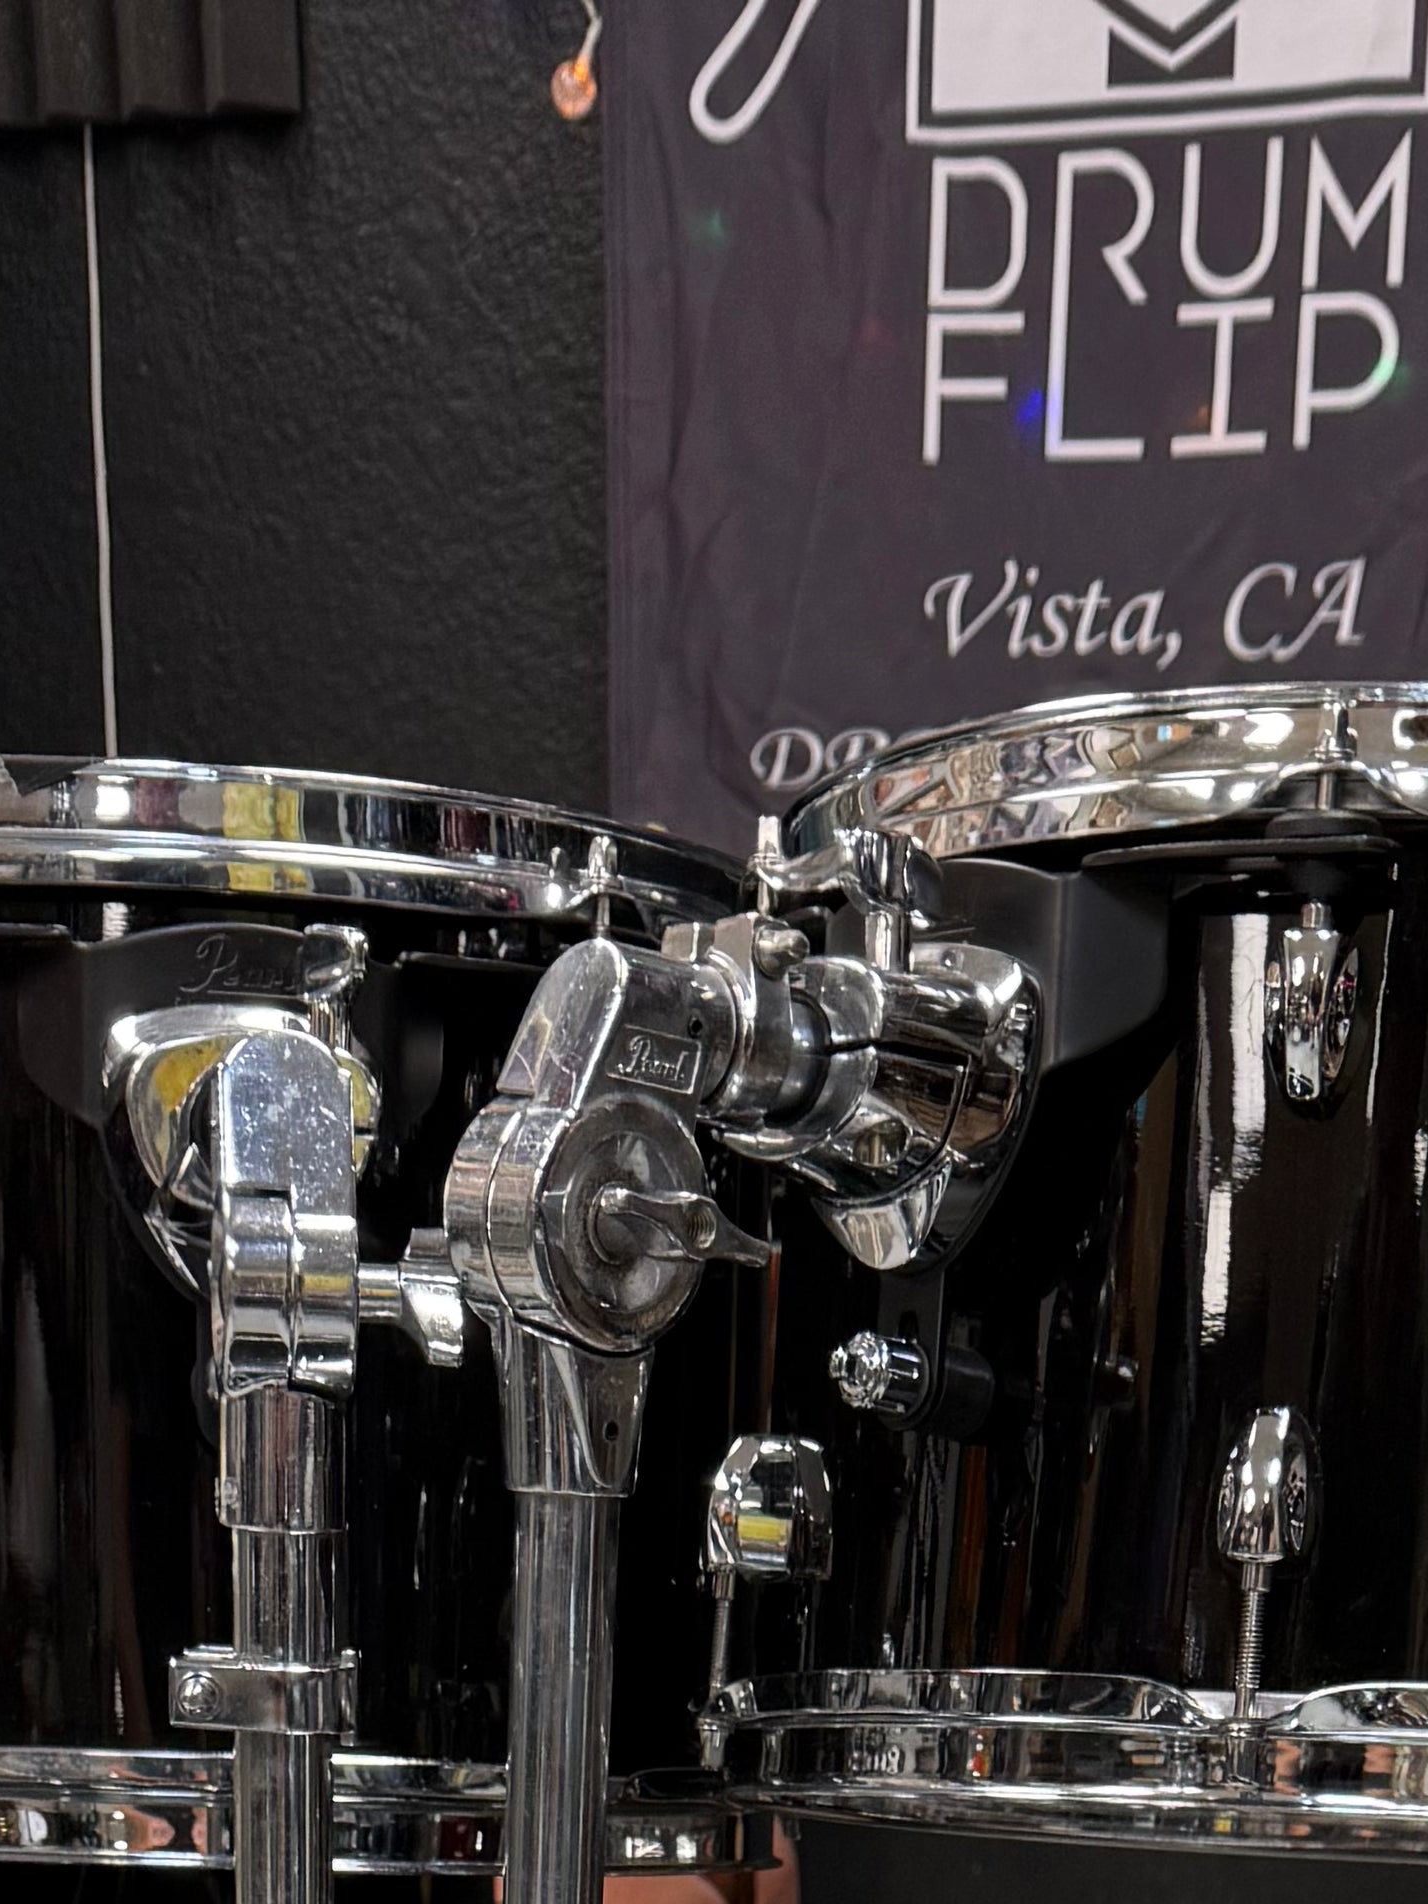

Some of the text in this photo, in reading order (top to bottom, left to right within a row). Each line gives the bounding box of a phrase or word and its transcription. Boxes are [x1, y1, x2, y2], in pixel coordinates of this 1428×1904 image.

[927, 130, 1414, 308] DRUM
[922, 291, 1401, 465] FLIP
[923, 557, 1369, 668] Vista, CA
